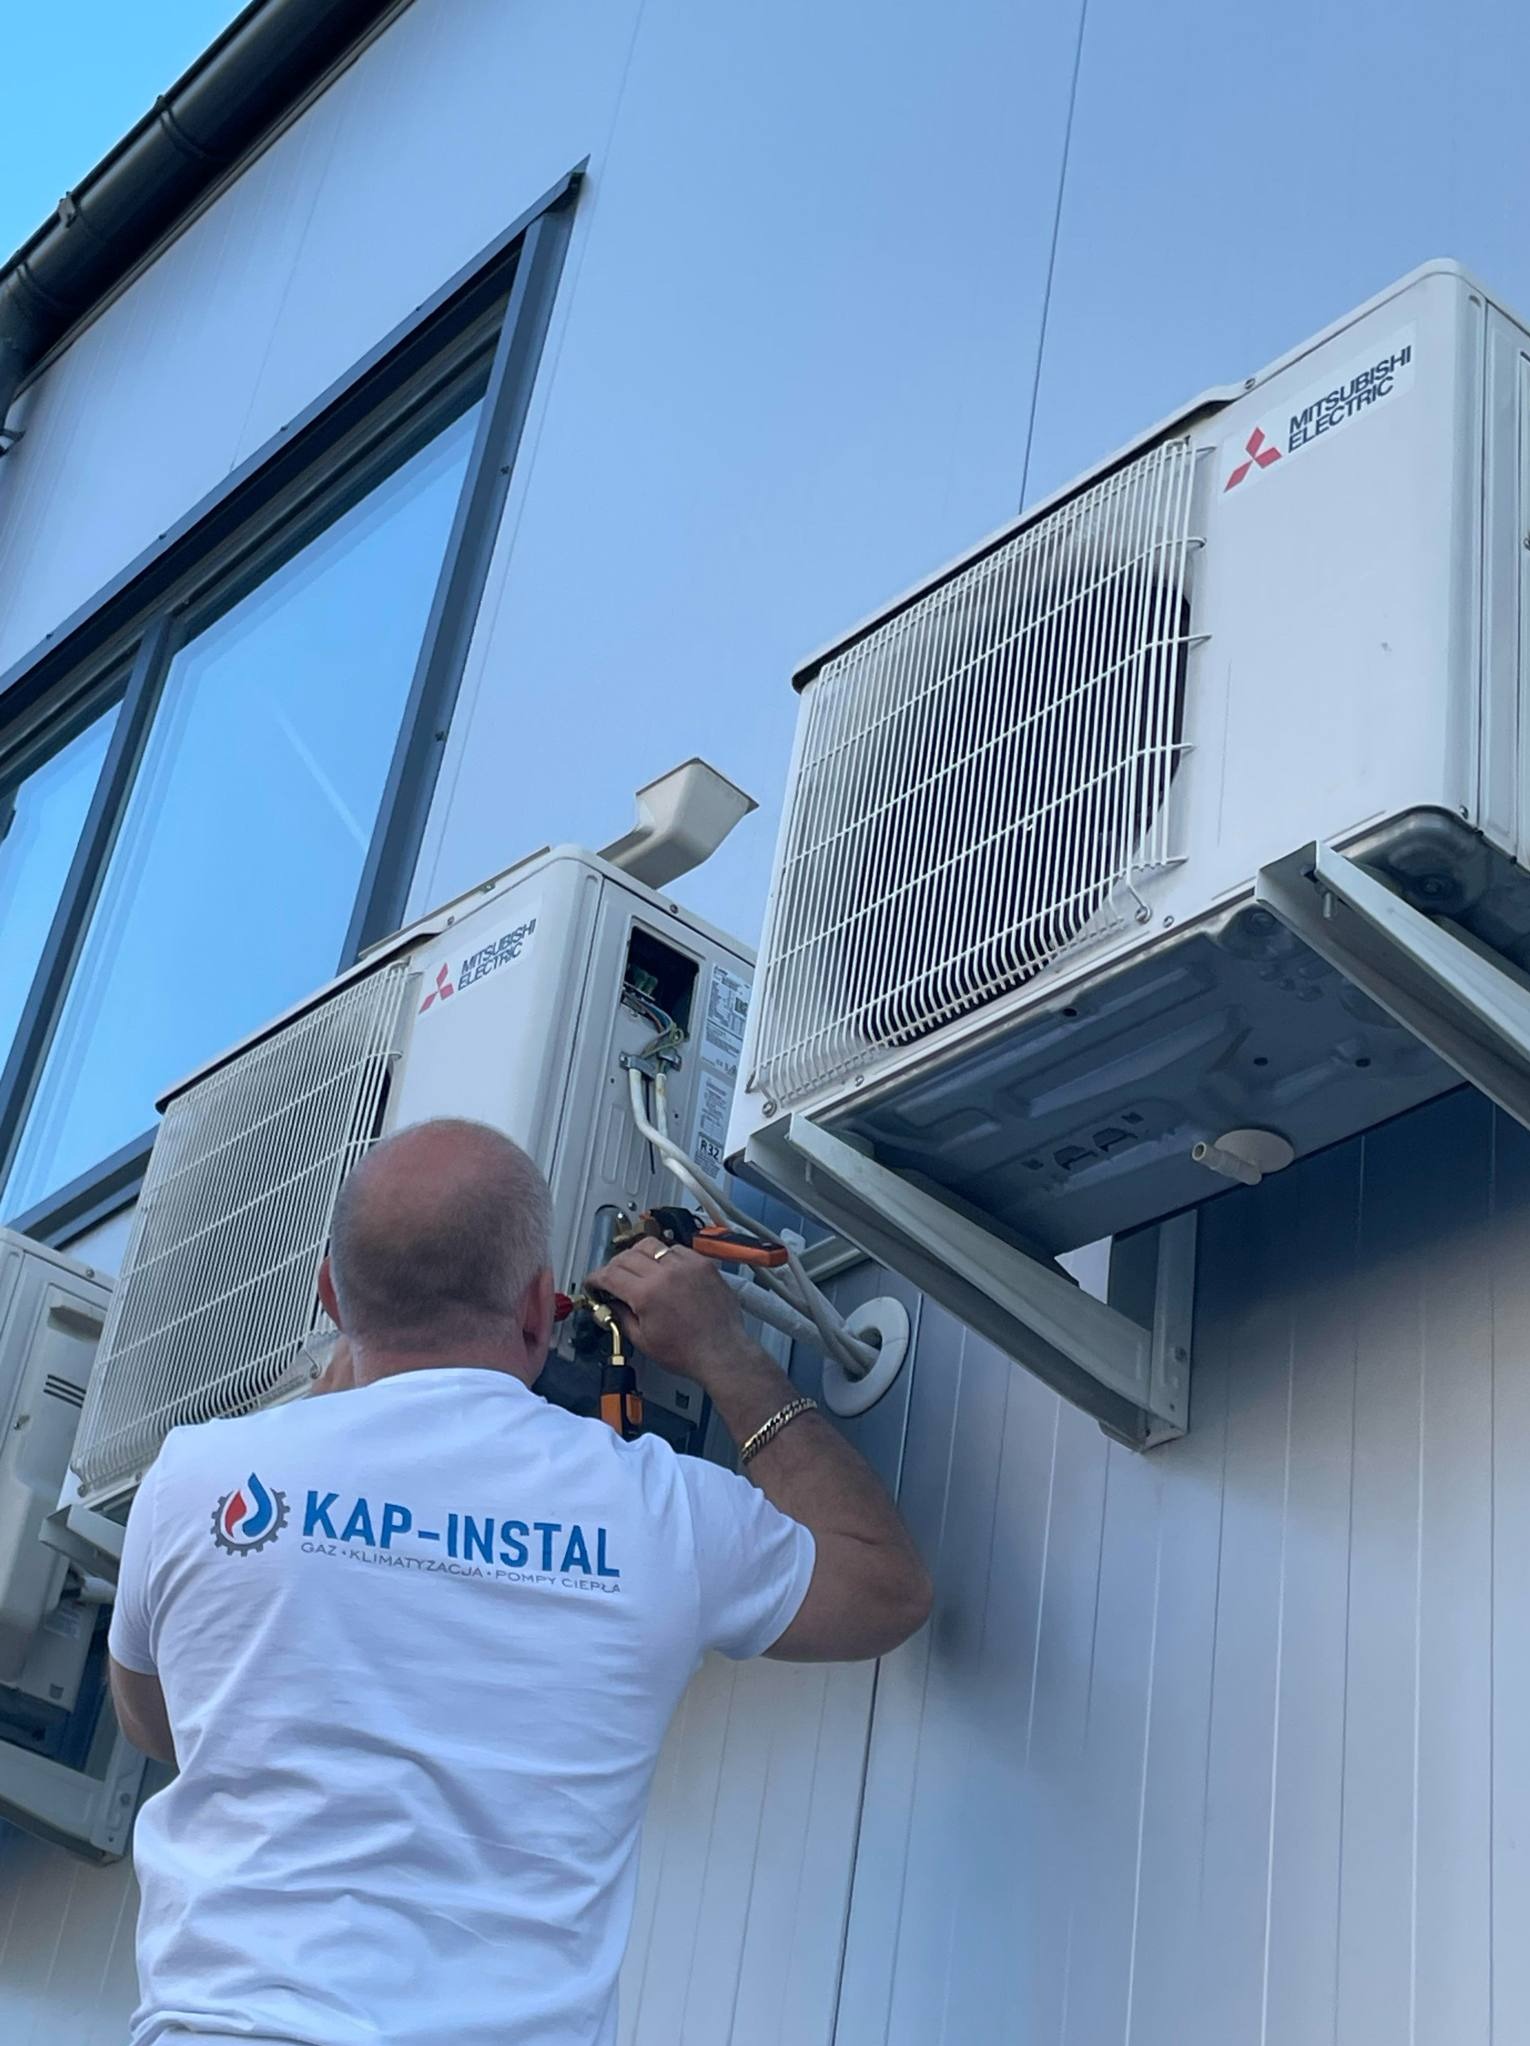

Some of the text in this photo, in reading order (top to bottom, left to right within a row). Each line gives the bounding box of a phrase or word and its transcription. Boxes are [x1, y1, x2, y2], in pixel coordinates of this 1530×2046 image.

[1288, 376, 1393, 453] ELECTRIC
[1289, 345, 1411, 434] MITSUBISHI
[458, 942, 522, 990] ELECTRIC
[461, 918, 536, 974] MITSUBISHI
[701, 1139, 720, 1160] R32
[303, 1490, 620, 1577] KAP-INSTAL
[301, 1542, 336, 1556] GAZ
[350, 1550, 484, 1578] KLIMATYZACJA
[496, 1569, 556, 1585] POMPY
